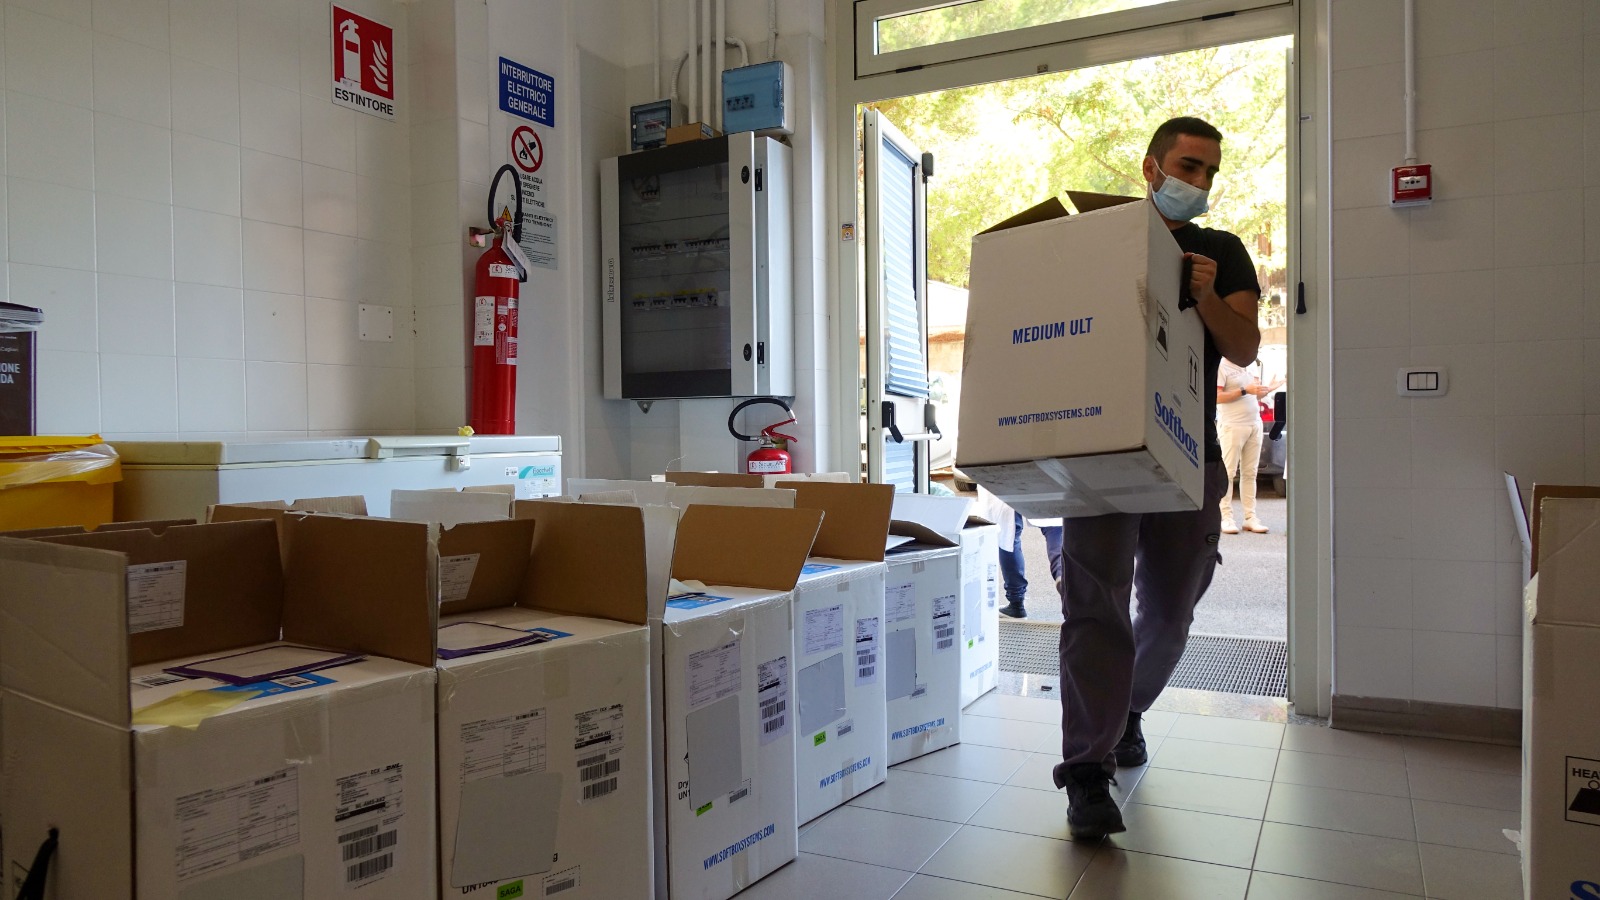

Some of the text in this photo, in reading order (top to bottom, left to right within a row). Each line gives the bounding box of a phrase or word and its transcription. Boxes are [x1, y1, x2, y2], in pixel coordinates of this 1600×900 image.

[501, 62, 552, 92] INTERRUTTORE
[335, 87, 394, 115] ESTINTORE
[507, 80, 546, 105] ELETTRICO
[508, 96, 547, 120] GENERALE
[1012, 317, 1094, 345] MEDIUM ULT
[998, 405, 1102, 427] WWW.SOFTBOXSYSTEMS.COM
[1154, 391, 1199, 461] Softbox
[678, 781, 689, 790] Dry
[1572, 767, 1600, 781] HEA
[703, 823, 775, 871] WWW.SOFTBOXSYSTEMS.COM
[500, 884, 521, 898] SAGA
